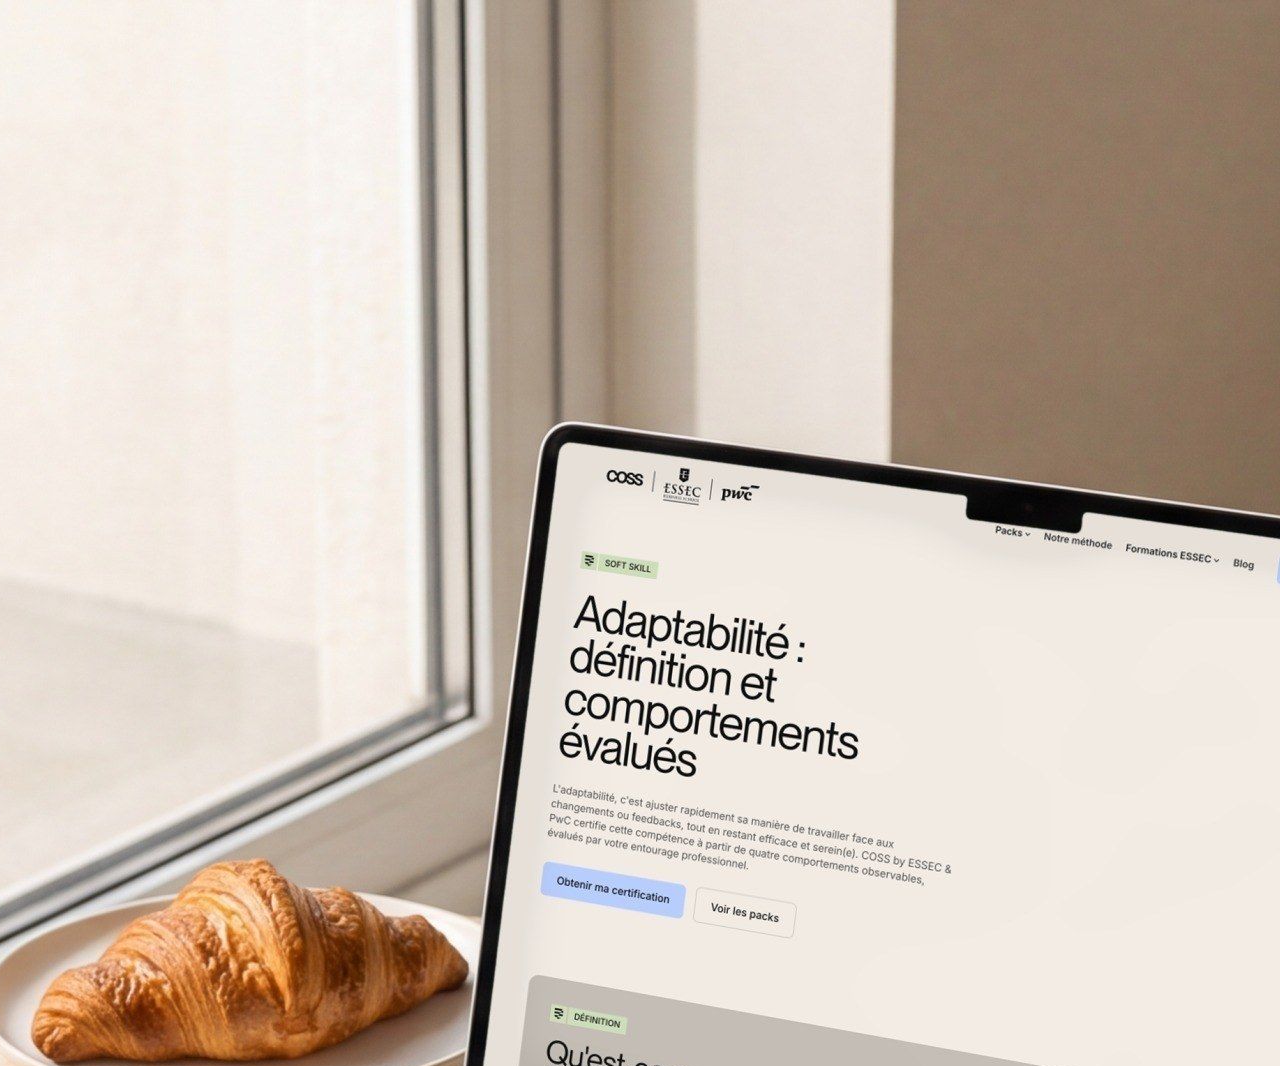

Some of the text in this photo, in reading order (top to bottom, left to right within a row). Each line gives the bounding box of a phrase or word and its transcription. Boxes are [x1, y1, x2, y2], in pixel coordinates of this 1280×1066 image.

[663, 482, 702, 498] ESSEC
[995, 525, 1023, 538] Packs
[1043, 532, 1113, 550] Notre méthode
[604, 559, 651, 574] SOFT SKILL
[1125, 543, 1212, 564] Formations ESSEC
[1233, 558, 1255, 571] Blog
[573, 595, 805, 663] Adaptabilité :
[569, 638, 778, 703] définition et
[564, 689, 859, 760] comportements
[559, 722, 697, 778] évalués
[552, 783, 617, 804] L'adaptabilité,
[645, 800, 678, 813] ajuster
[680, 806, 735, 823] rapidement
[737, 816, 749, 825] sa
[750, 818, 791, 832] manière
[792, 823, 805, 834] de
[807, 826, 850, 841] travailler
[851, 833, 874, 846] face
[875, 839, 895, 849] aux
[547, 827, 749, 870] évalués par votre entourage professionnel.
[549, 813, 925, 886] PwC certifie cette compétence à partir de quatre comportements observables,
[550, 799, 952, 874] changements ou feedbacks, tout en restant efficace et serein(e). COSS by ESSEC &
[556, 876, 670, 904] Obtenir ma certification
[711, 902, 780, 923] Voir les packs
[574, 1012, 621, 1028] DÉFINITION
